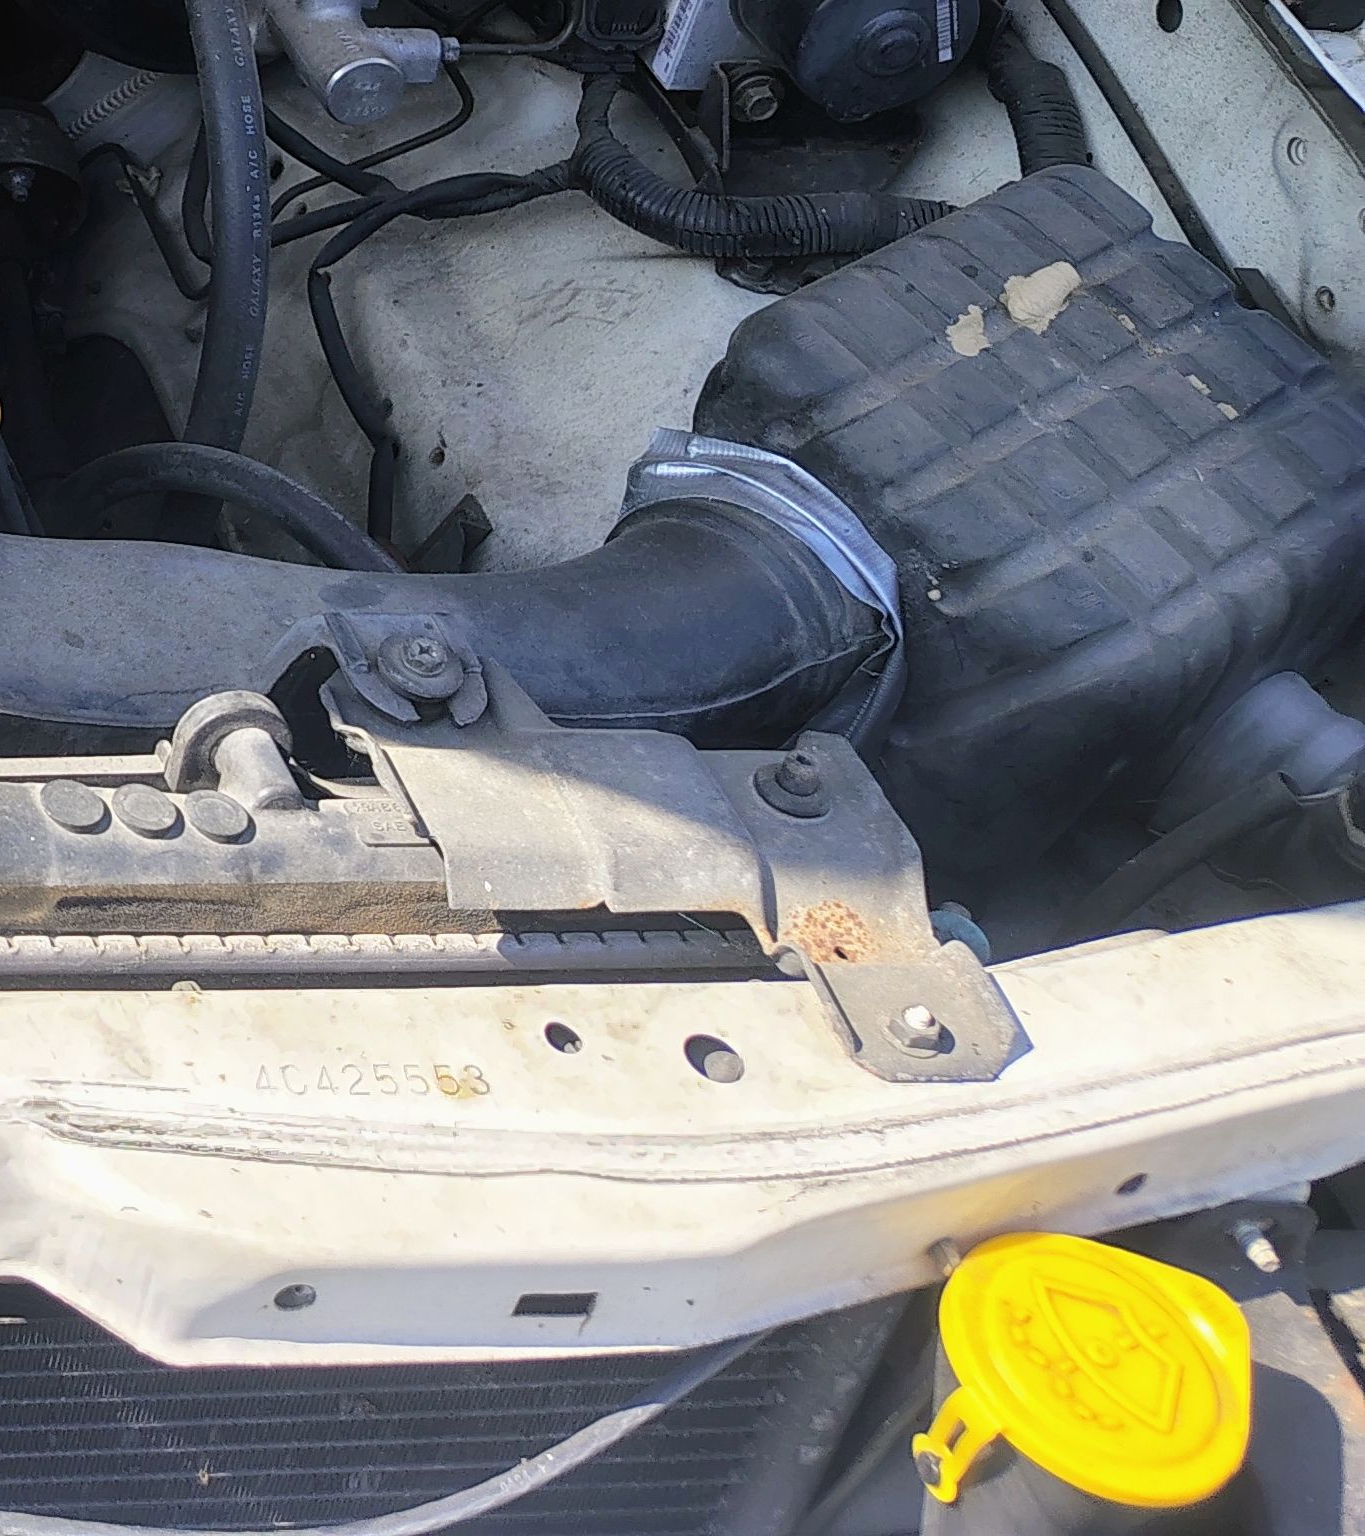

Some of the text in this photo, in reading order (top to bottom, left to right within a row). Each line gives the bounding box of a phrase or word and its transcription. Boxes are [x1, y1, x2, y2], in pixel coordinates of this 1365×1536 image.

[225, 8, 246, 68] GALAXY
[243, 94, 254, 136] HOSE
[251, 149, 259, 182] A/C
[249, 253, 264, 318] GALAXY
